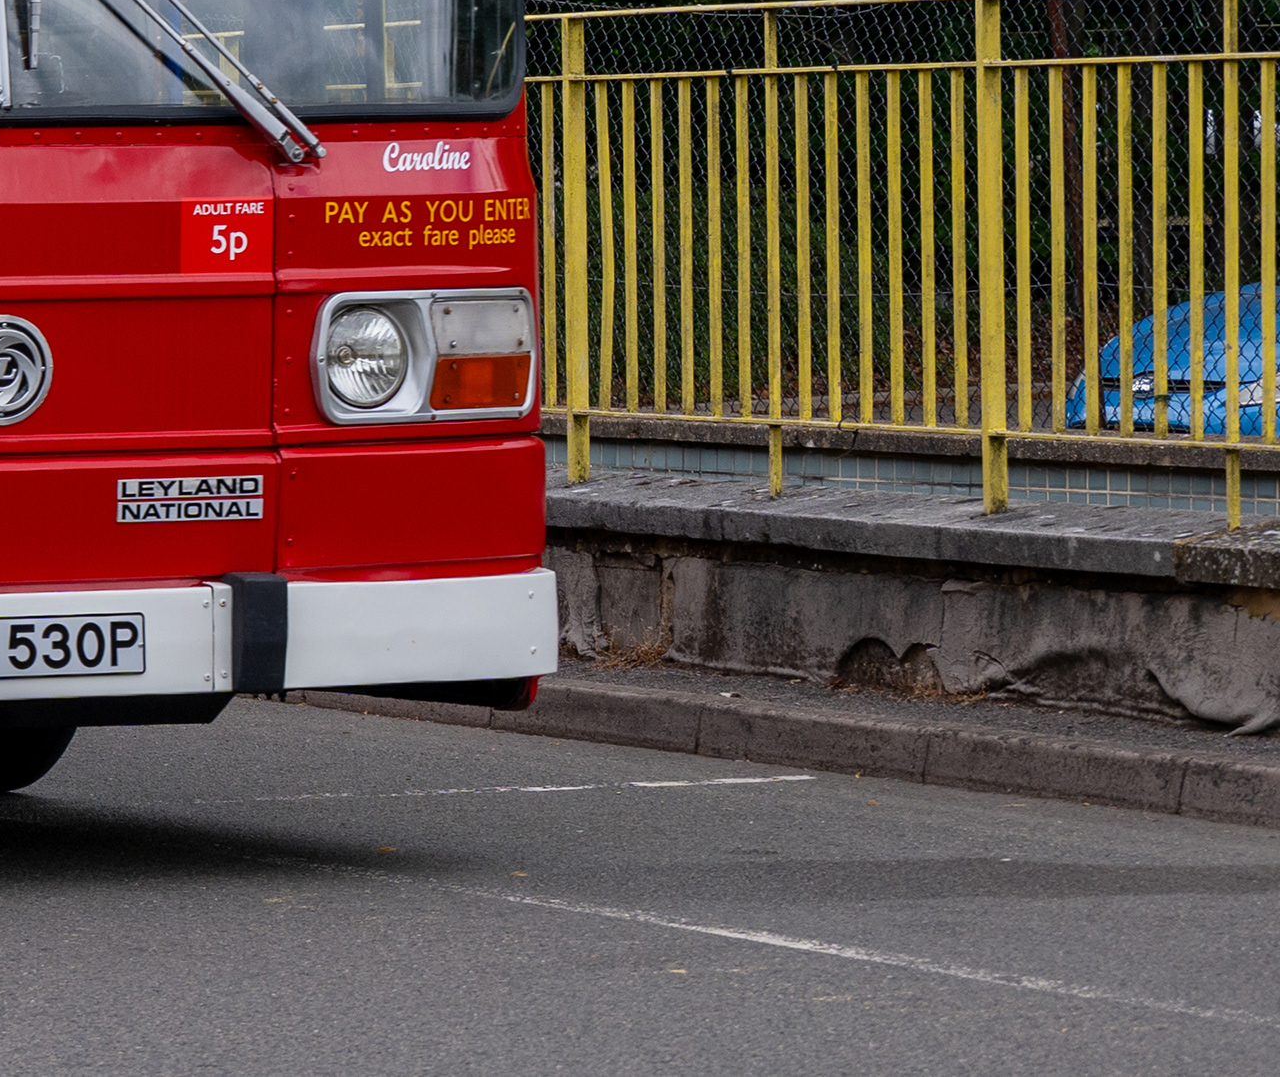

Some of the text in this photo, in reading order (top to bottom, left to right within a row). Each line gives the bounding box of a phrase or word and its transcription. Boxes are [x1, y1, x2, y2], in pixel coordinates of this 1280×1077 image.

[382, 140, 471, 172] Caroline
[193, 202, 265, 216] ADULT FARE
[325, 198, 531, 223] PAY AS YOU ENTER
[210, 225, 248, 260] 5p
[359, 224, 516, 250] exact fare please
[122, 477, 260, 498] LEYLAND
[121, 501, 260, 520] NATIONAL
[7, 620, 139, 671] 530P
